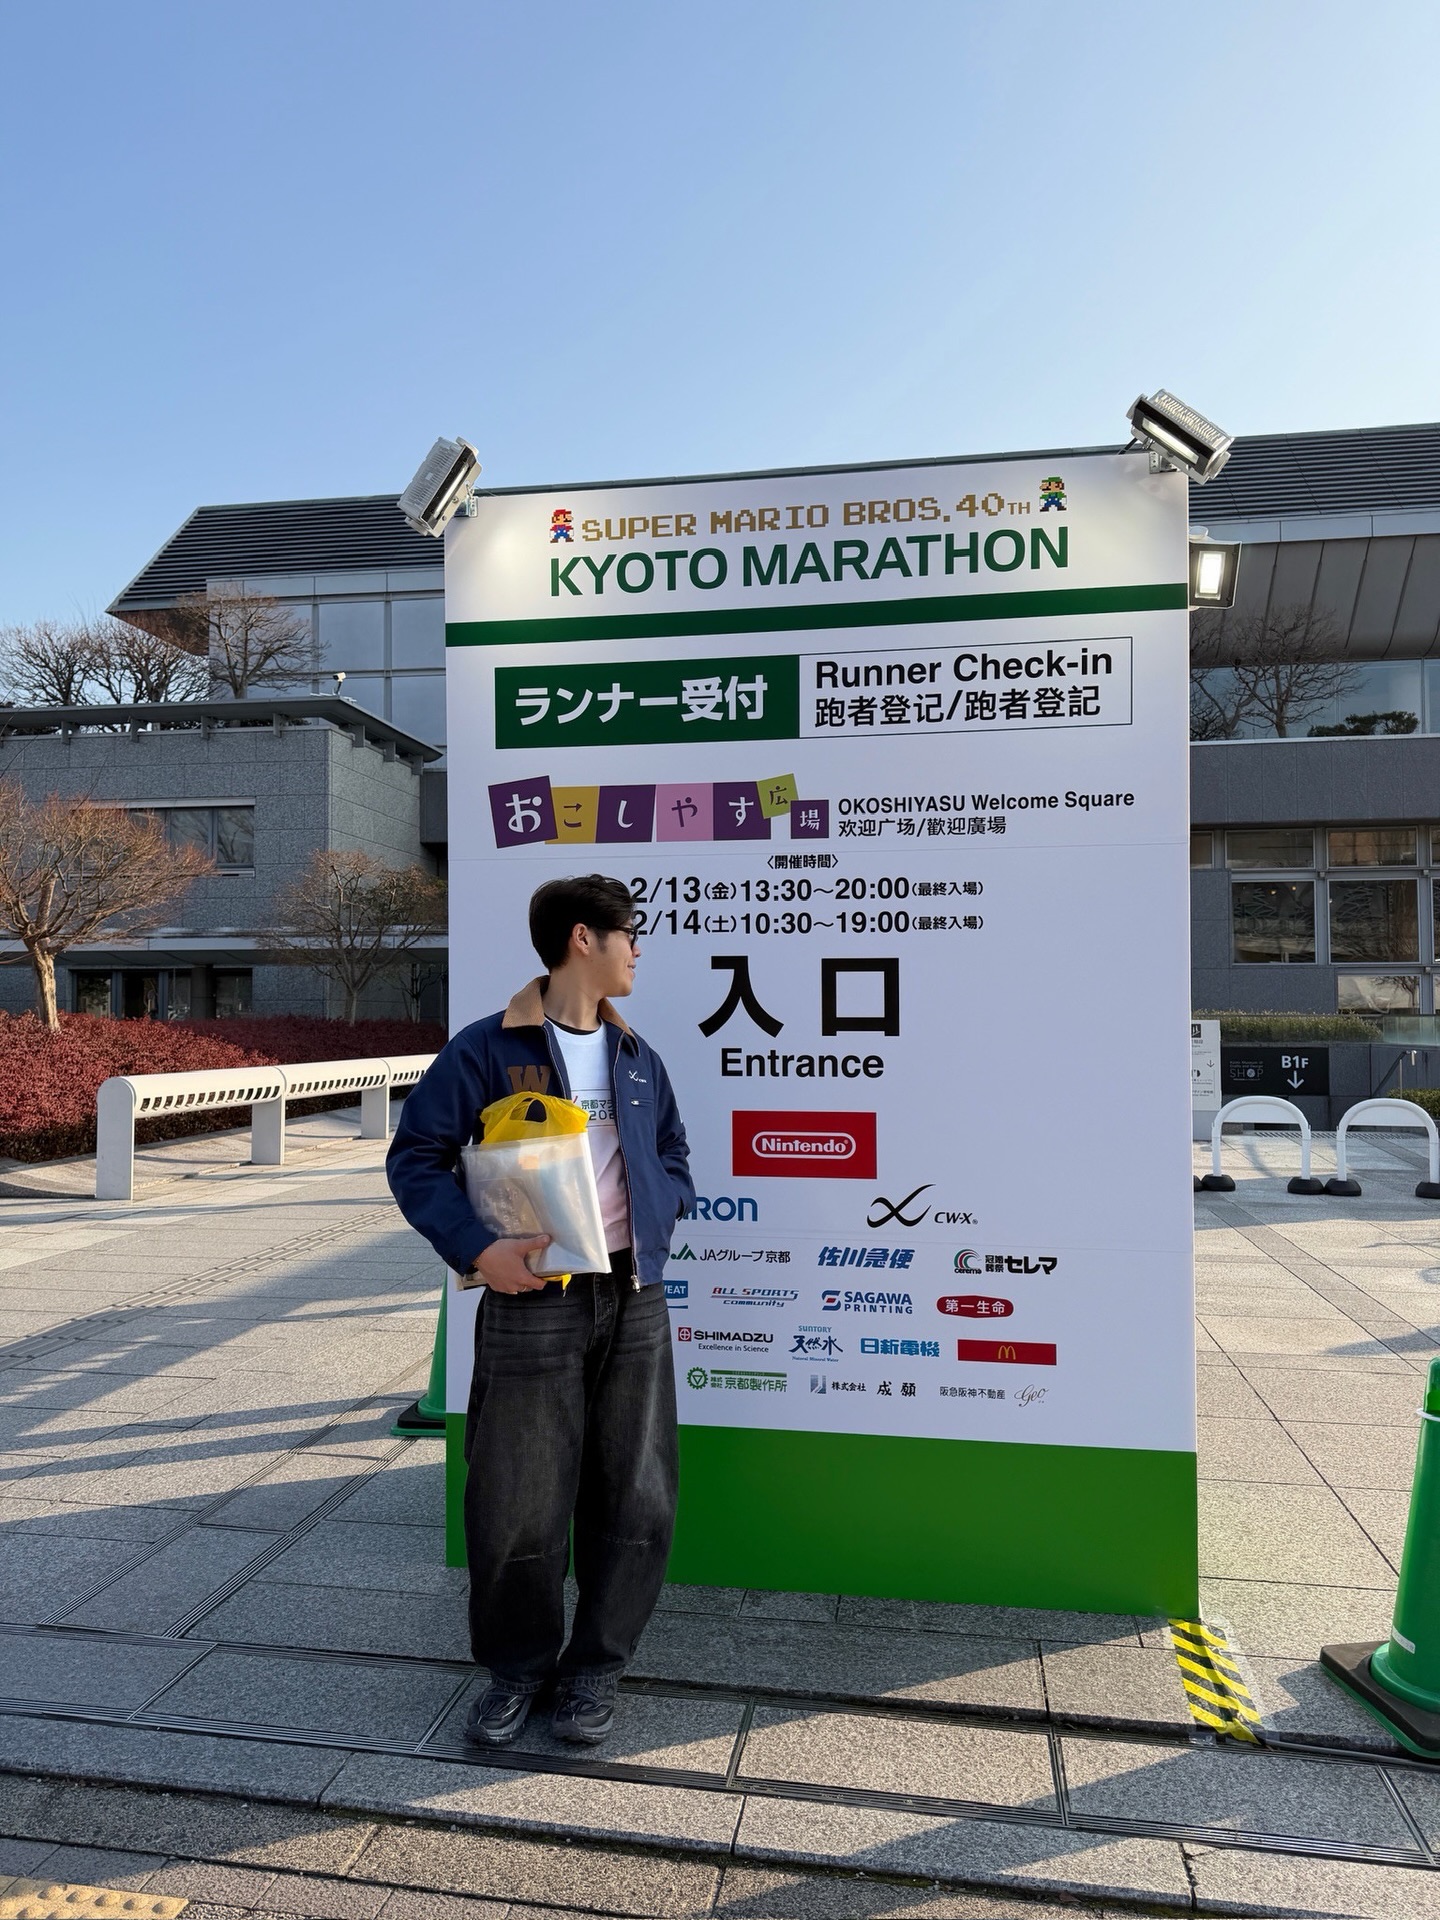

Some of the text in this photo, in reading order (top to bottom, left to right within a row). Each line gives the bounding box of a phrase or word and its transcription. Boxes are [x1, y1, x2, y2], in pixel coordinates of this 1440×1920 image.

[582, 514, 697, 542] SUPER
[711, 504, 829, 534] MARIO
[551, 526, 1069, 597] KYOTO MARATHON
[816, 648, 1112, 689] Runner Check-in
[515, 674, 769, 726] ランナー受付
[815, 685, 1101, 728] 跑者登记/跑者登記
[838, 790, 1135, 816] OKOSHIYASU Welcome Square
[838, 816, 1007, 837] 欢迎广场/歡迎廣場
[697, 955, 900, 1038] 入口
[721, 1048, 884, 1078] Entrance
[1281, 1055, 1309, 1068] B1F
[508, 1065, 550, 1094] W
[761, 1138, 847, 1154] Nintendo
[817, 1246, 915, 1269] 佐川急便
[1004, 1255, 1058, 1274] セレマ
[713, 1287, 799, 1299] ALL SPORTS
[844, 1290, 913, 1305] SAGAWA
[723, 1299, 785, 1308] community
[844, 1304, 913, 1314] PRINTING
[945, 1299, 1005, 1315] 第一生命
[693, 1330, 774, 1343] SHIMADZU
[789, 1335, 844, 1355] 天然水
[698, 1343, 769, 1353] Excellence in Science
[861, 1338, 940, 1357] 日新電機
[725, 1377, 787, 1392] 京都製作所
